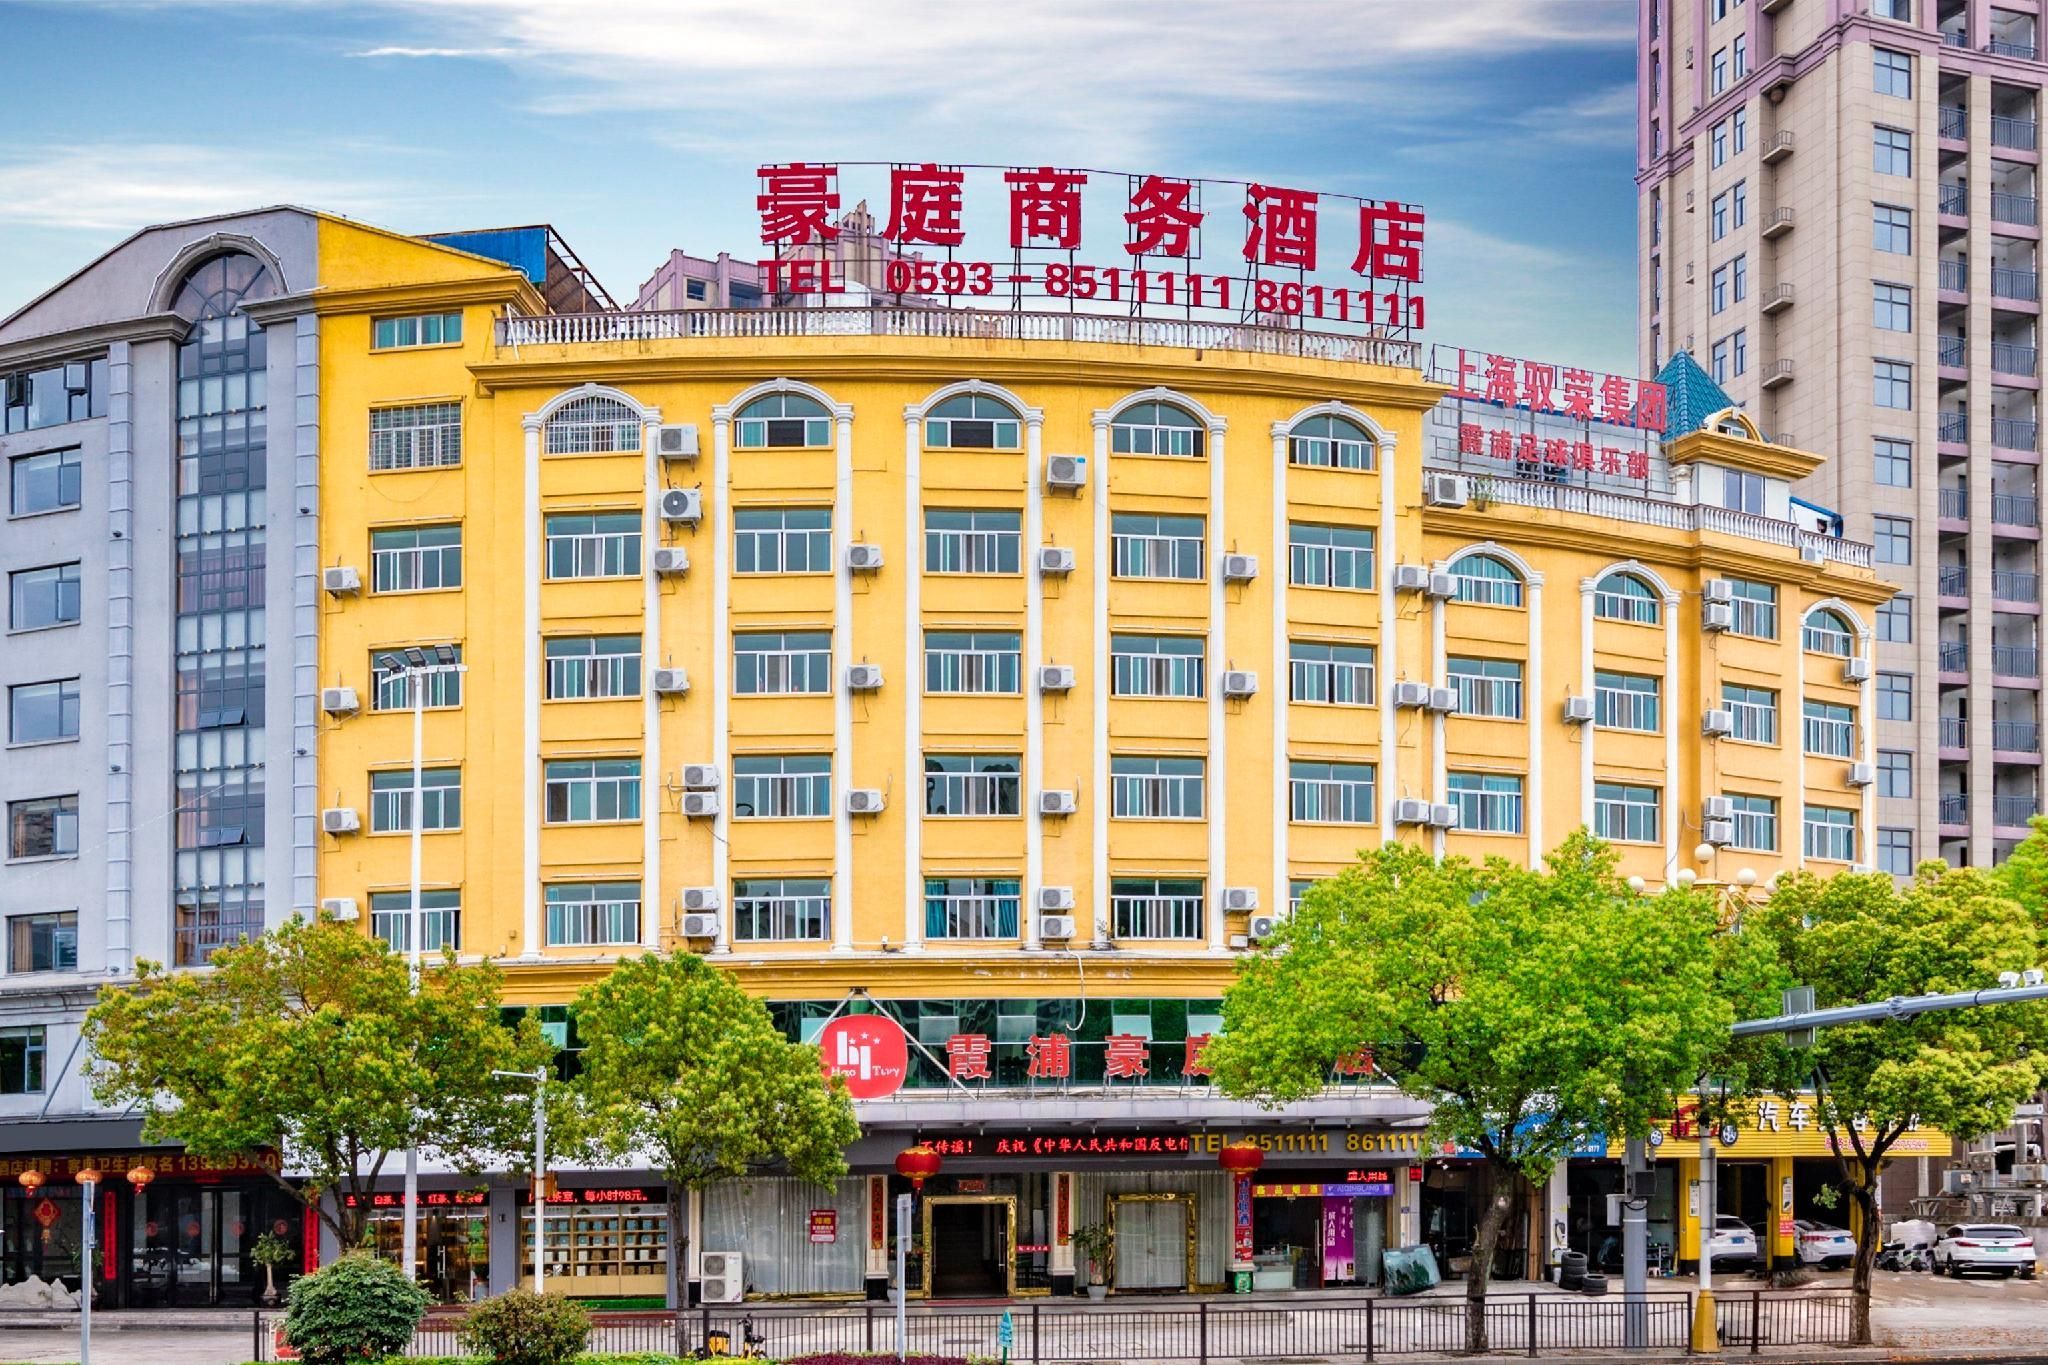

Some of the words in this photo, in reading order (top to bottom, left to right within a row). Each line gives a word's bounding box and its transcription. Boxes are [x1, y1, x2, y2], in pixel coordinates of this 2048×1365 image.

[757, 162, 1425, 283] 豪庭商务酒店
[757, 259, 846, 294] TEL
[1254, 279, 1425, 329] 8611111
[1448, 348, 1667, 433] 上海驭荣集团
[1459, 422, 1650, 480] 霞浦足球俱乐部
[1190, 1133, 1230, 1153] TEL
[1245, 1134, 1329, 1152] 8511111
